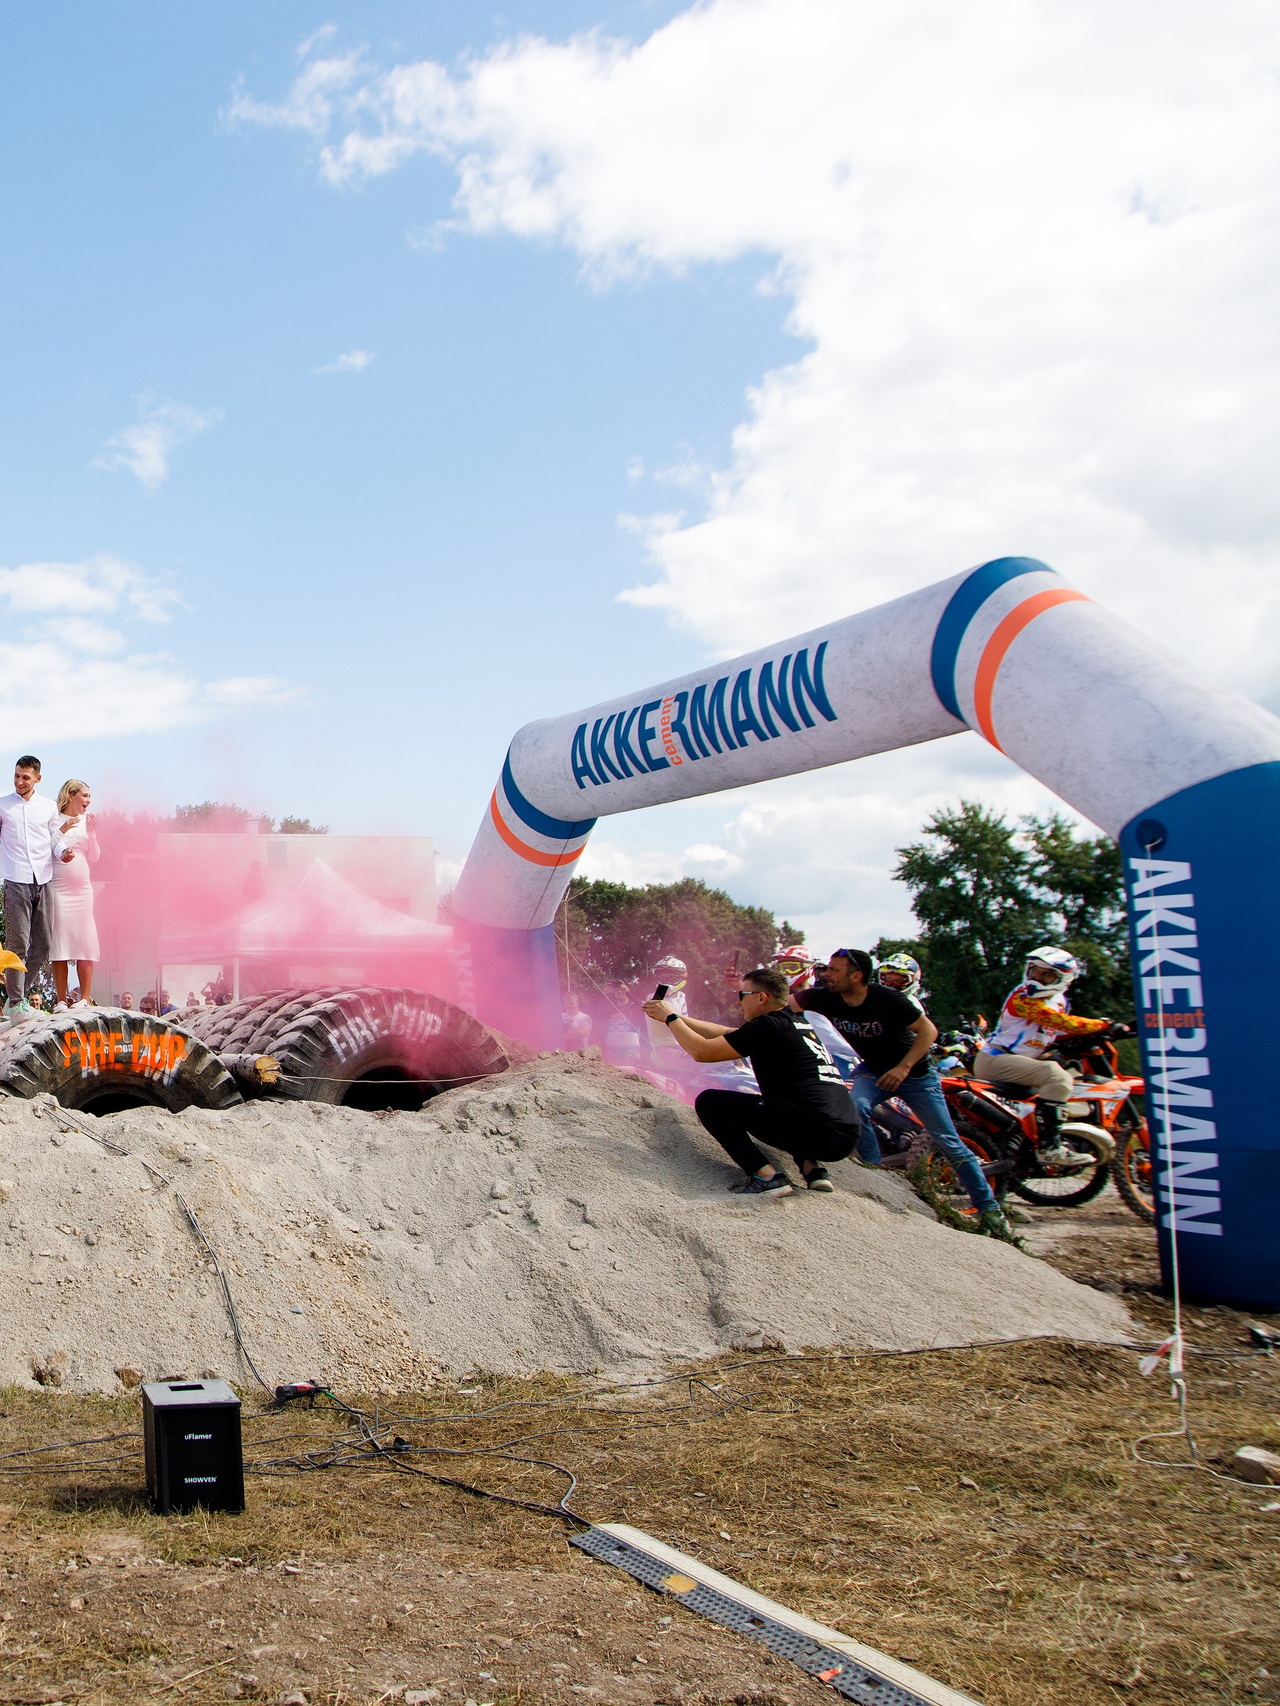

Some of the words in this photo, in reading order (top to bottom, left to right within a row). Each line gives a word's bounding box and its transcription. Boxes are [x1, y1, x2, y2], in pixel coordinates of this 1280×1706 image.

[571, 640, 838, 790] AKKERMANN
[661, 694, 684, 766] cement
[63, 1032, 124, 1071] FIRE
[131, 1033, 188, 1072] CUP
[328, 1005, 389, 1064] FIRE
[390, 1002, 442, 1044] CUP
[1128, 856, 1224, 1237] AKKERMANN
